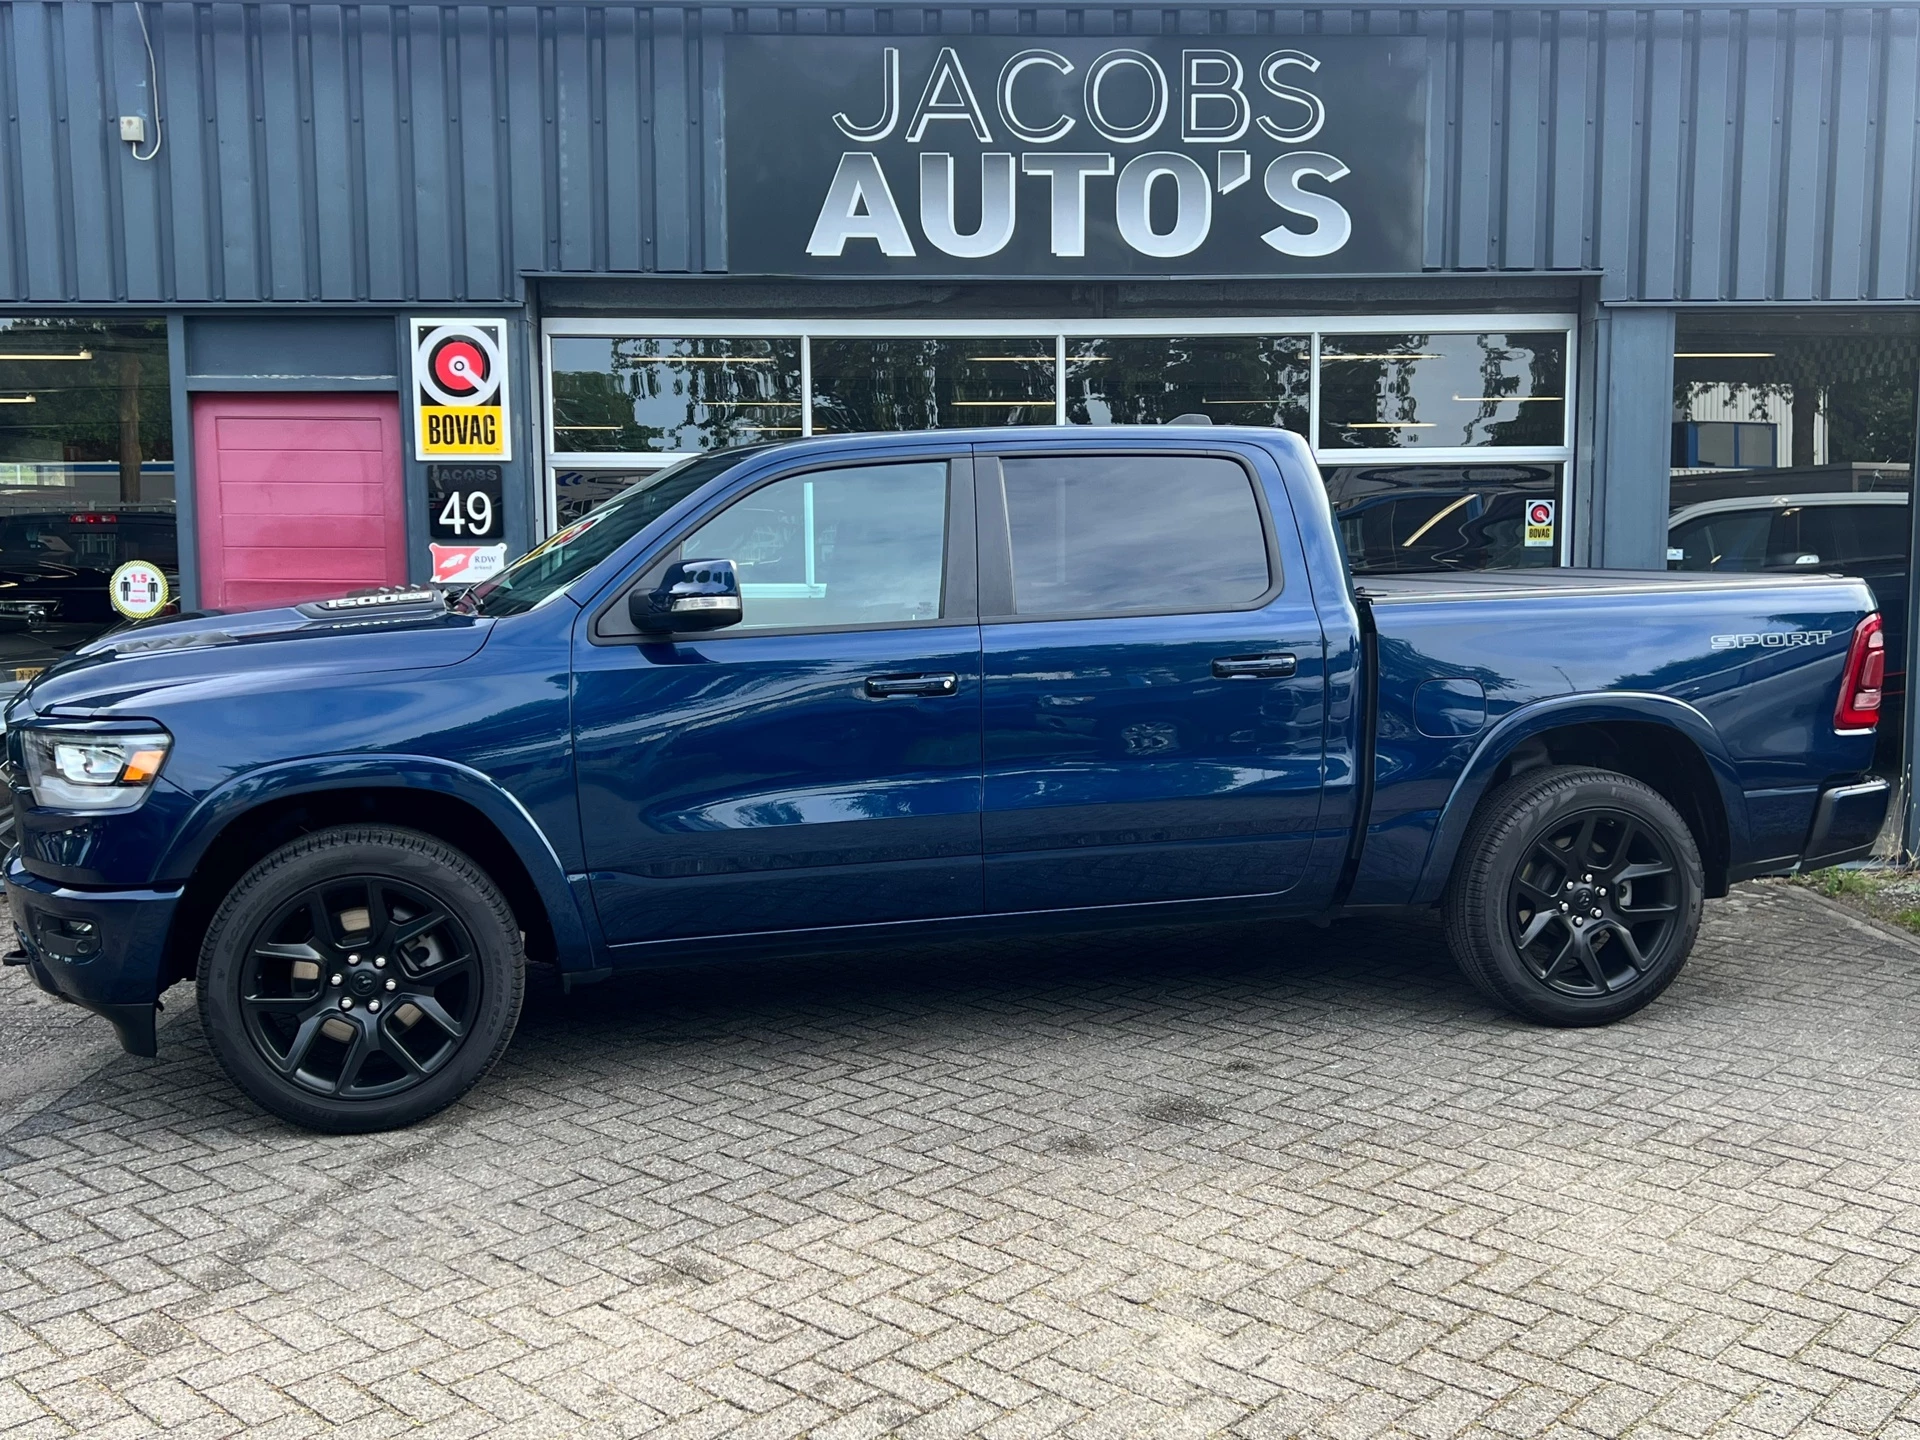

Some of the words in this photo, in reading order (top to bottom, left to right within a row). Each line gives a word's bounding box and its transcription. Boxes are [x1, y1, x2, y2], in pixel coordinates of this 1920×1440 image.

[832, 47, 1326, 143] JACOBS
[805, 150, 1352, 258] AUTO'S
[428, 414, 496, 445] BOVAG
[438, 491, 492, 535] 49
[1529, 528, 1550, 538] BOVAG
[131, 574, 147, 583] 1.5
[326, 594, 399, 608] 1500
[1710, 630, 1832, 650] SPORT
